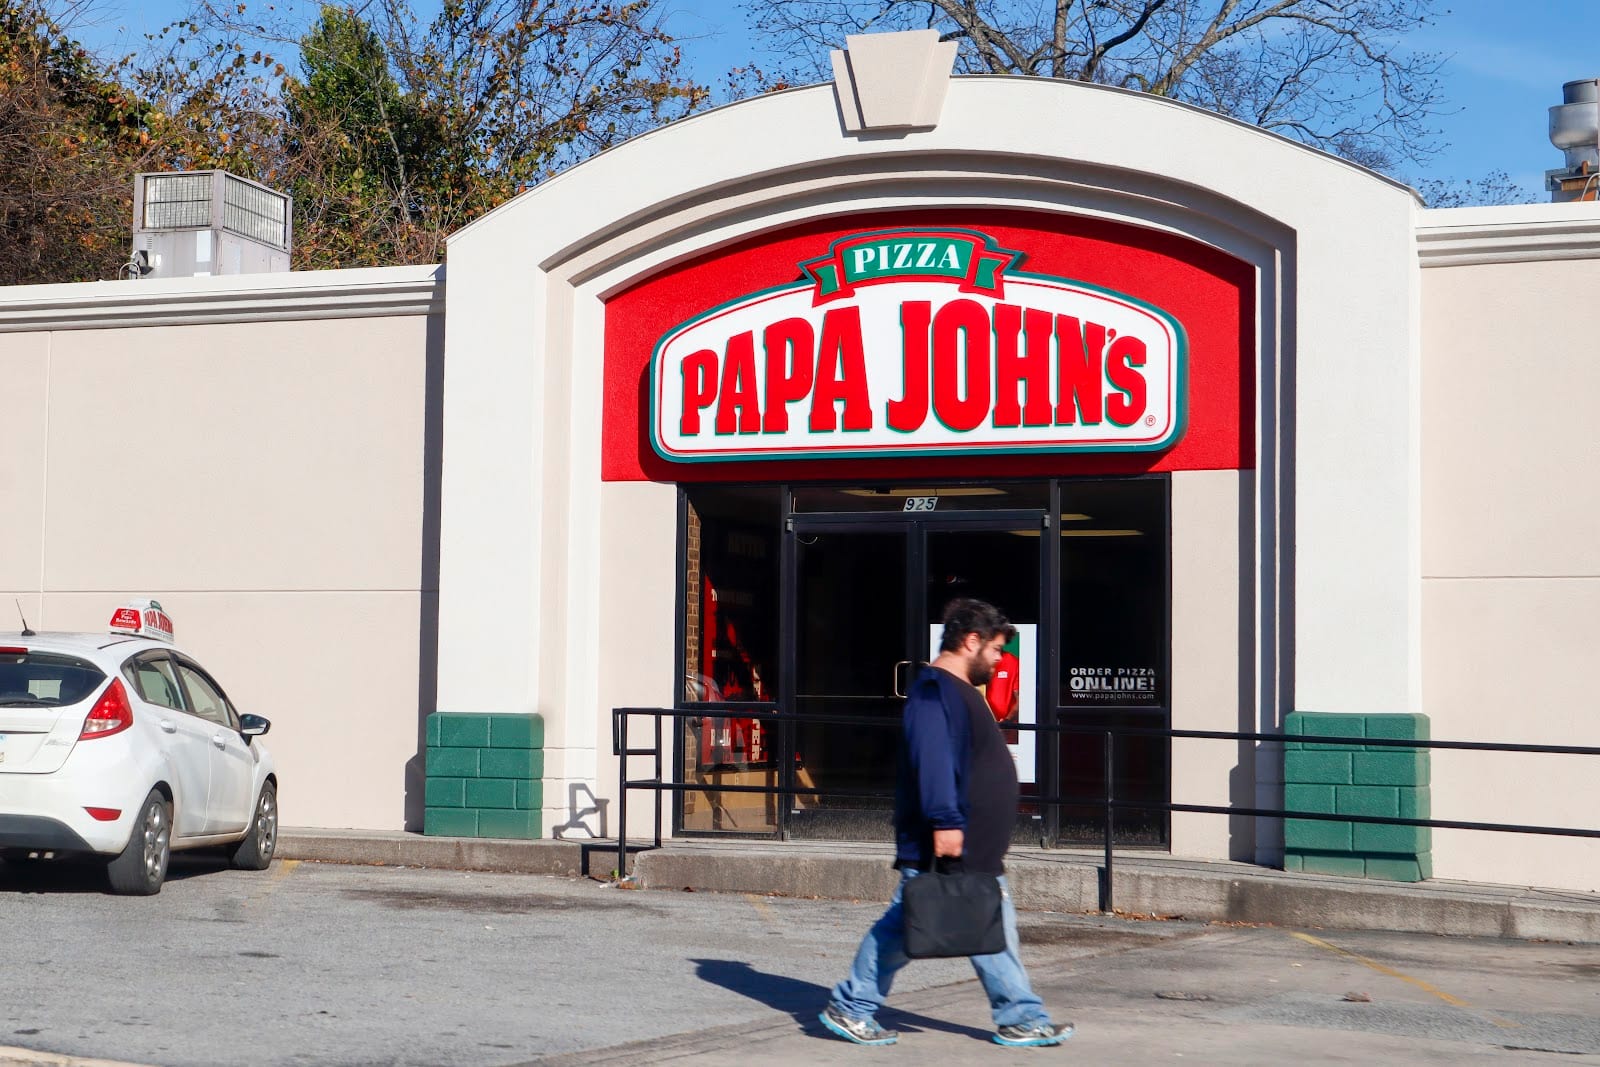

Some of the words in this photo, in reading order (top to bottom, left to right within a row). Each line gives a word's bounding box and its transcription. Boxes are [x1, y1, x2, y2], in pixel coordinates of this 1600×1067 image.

[852, 243, 962, 274] PIZZA
[680, 305, 873, 436] PAPA
[886, 298, 1147, 432] JOHN'S
[905, 498, 936, 511] 925
[1070, 667, 1112, 676] ORDER
[1117, 667, 1155, 676] PIZZA
[1070, 676, 1155, 690] ONLINE!
[1071, 692, 1155, 700] www.papajohns.com
